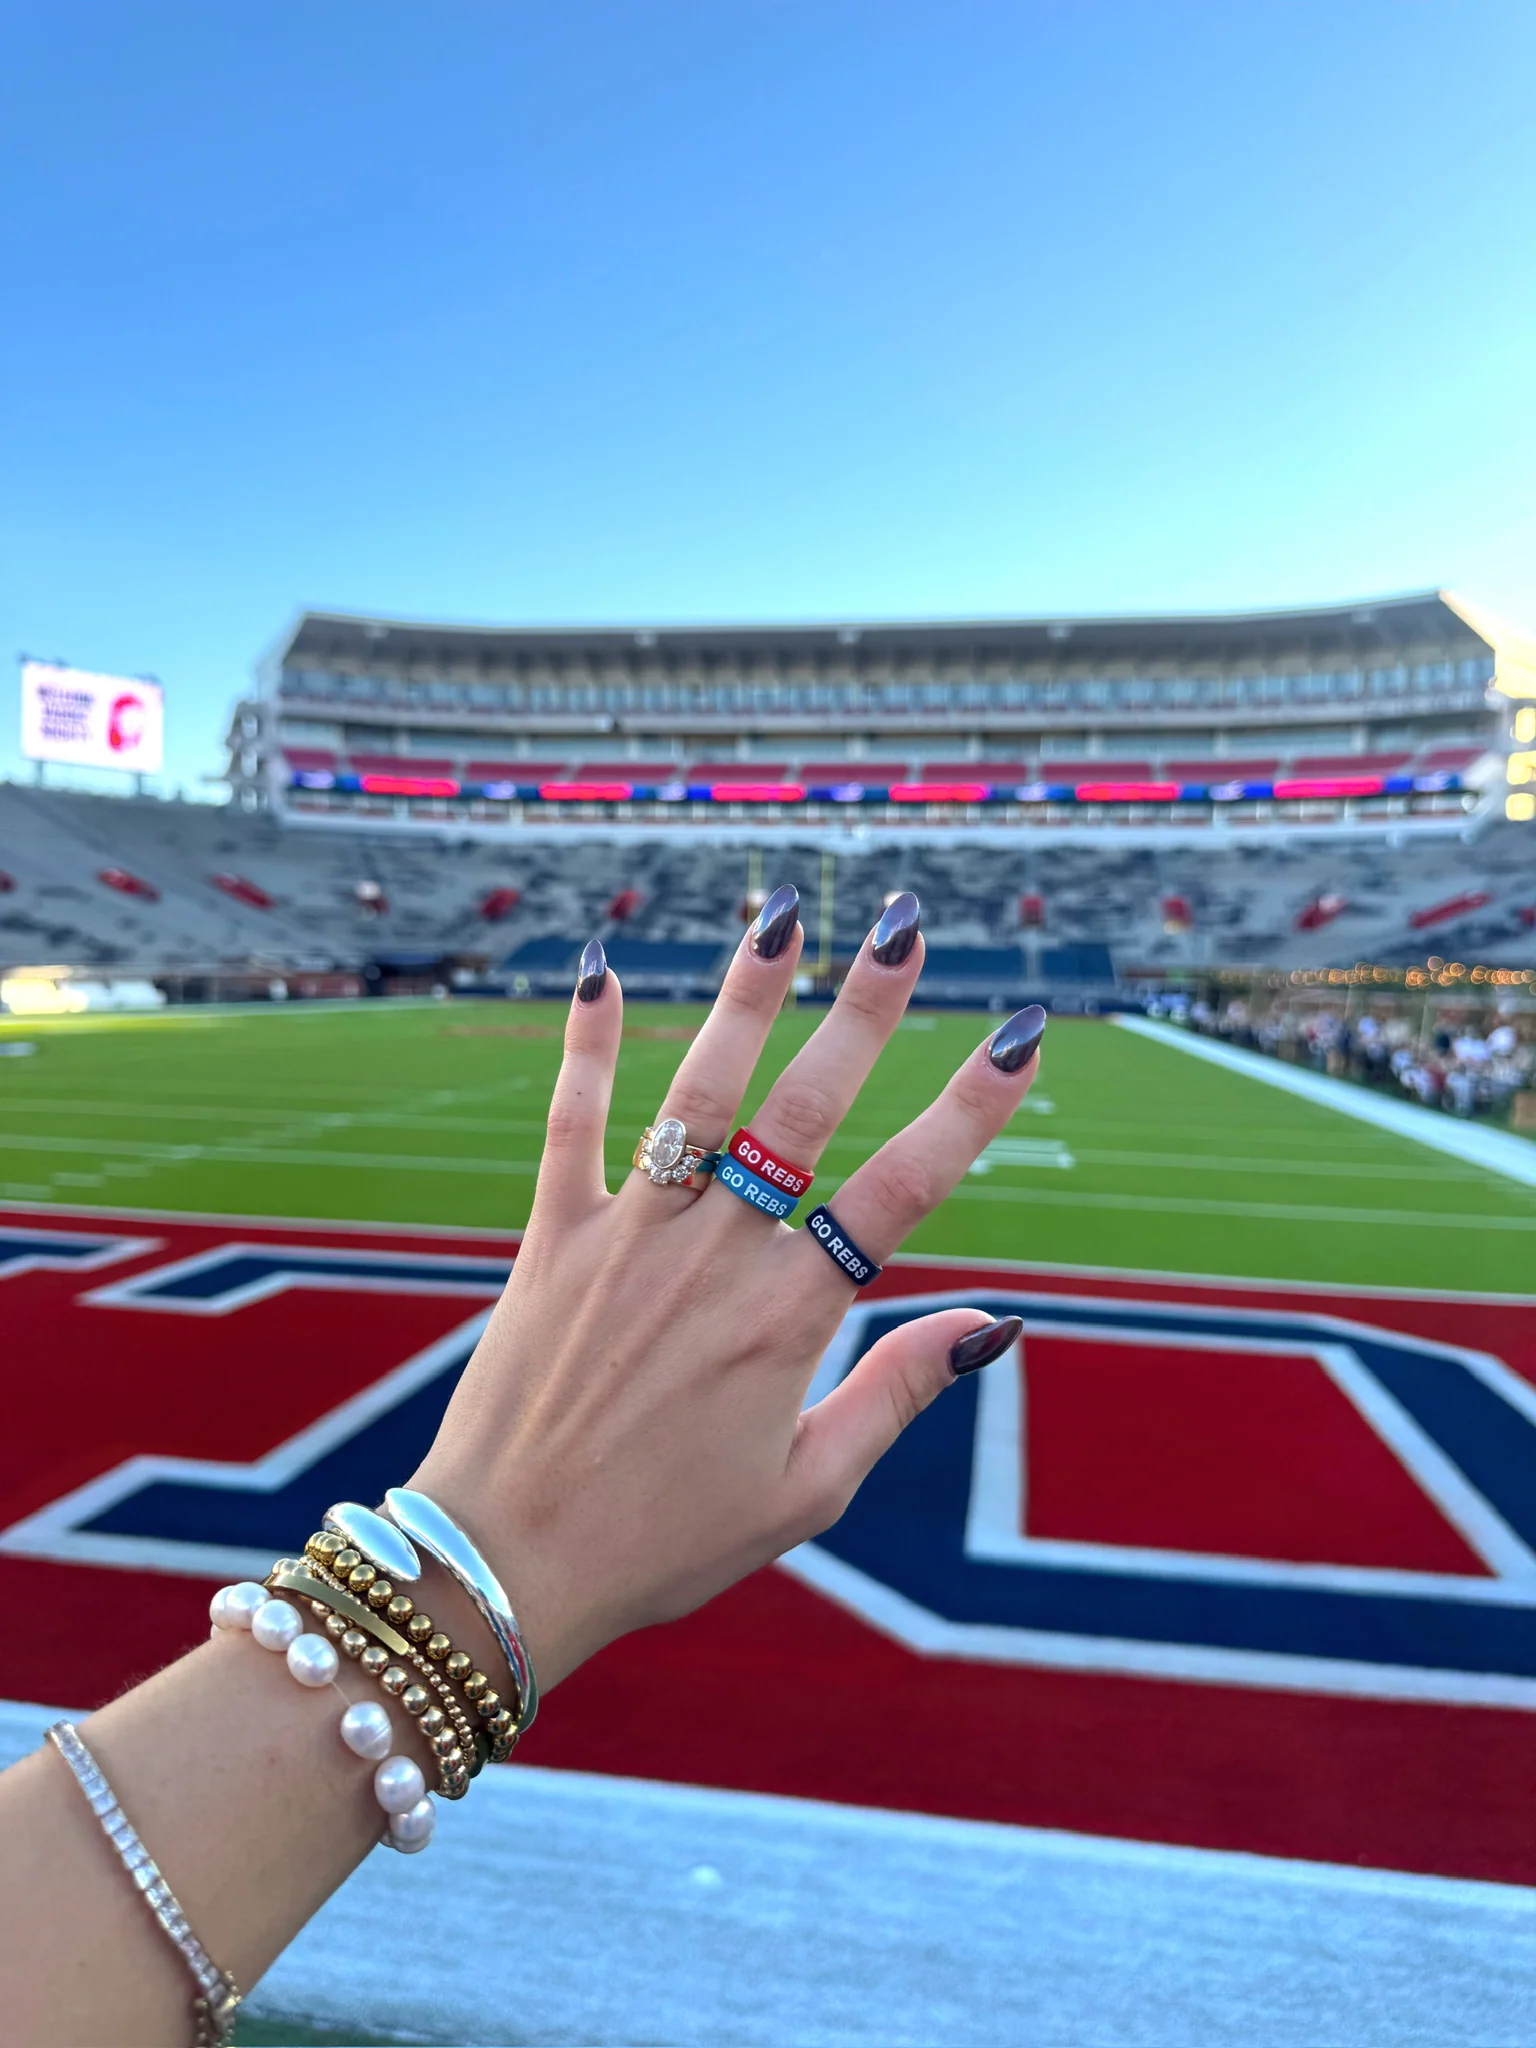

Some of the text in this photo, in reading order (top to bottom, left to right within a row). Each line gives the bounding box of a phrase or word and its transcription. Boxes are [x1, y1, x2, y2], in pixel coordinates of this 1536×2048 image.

[721, 1166, 787, 1216] GO REBS
[737, 1141, 804, 1192] GO REBS
[811, 1214, 869, 1279] GO REBS
